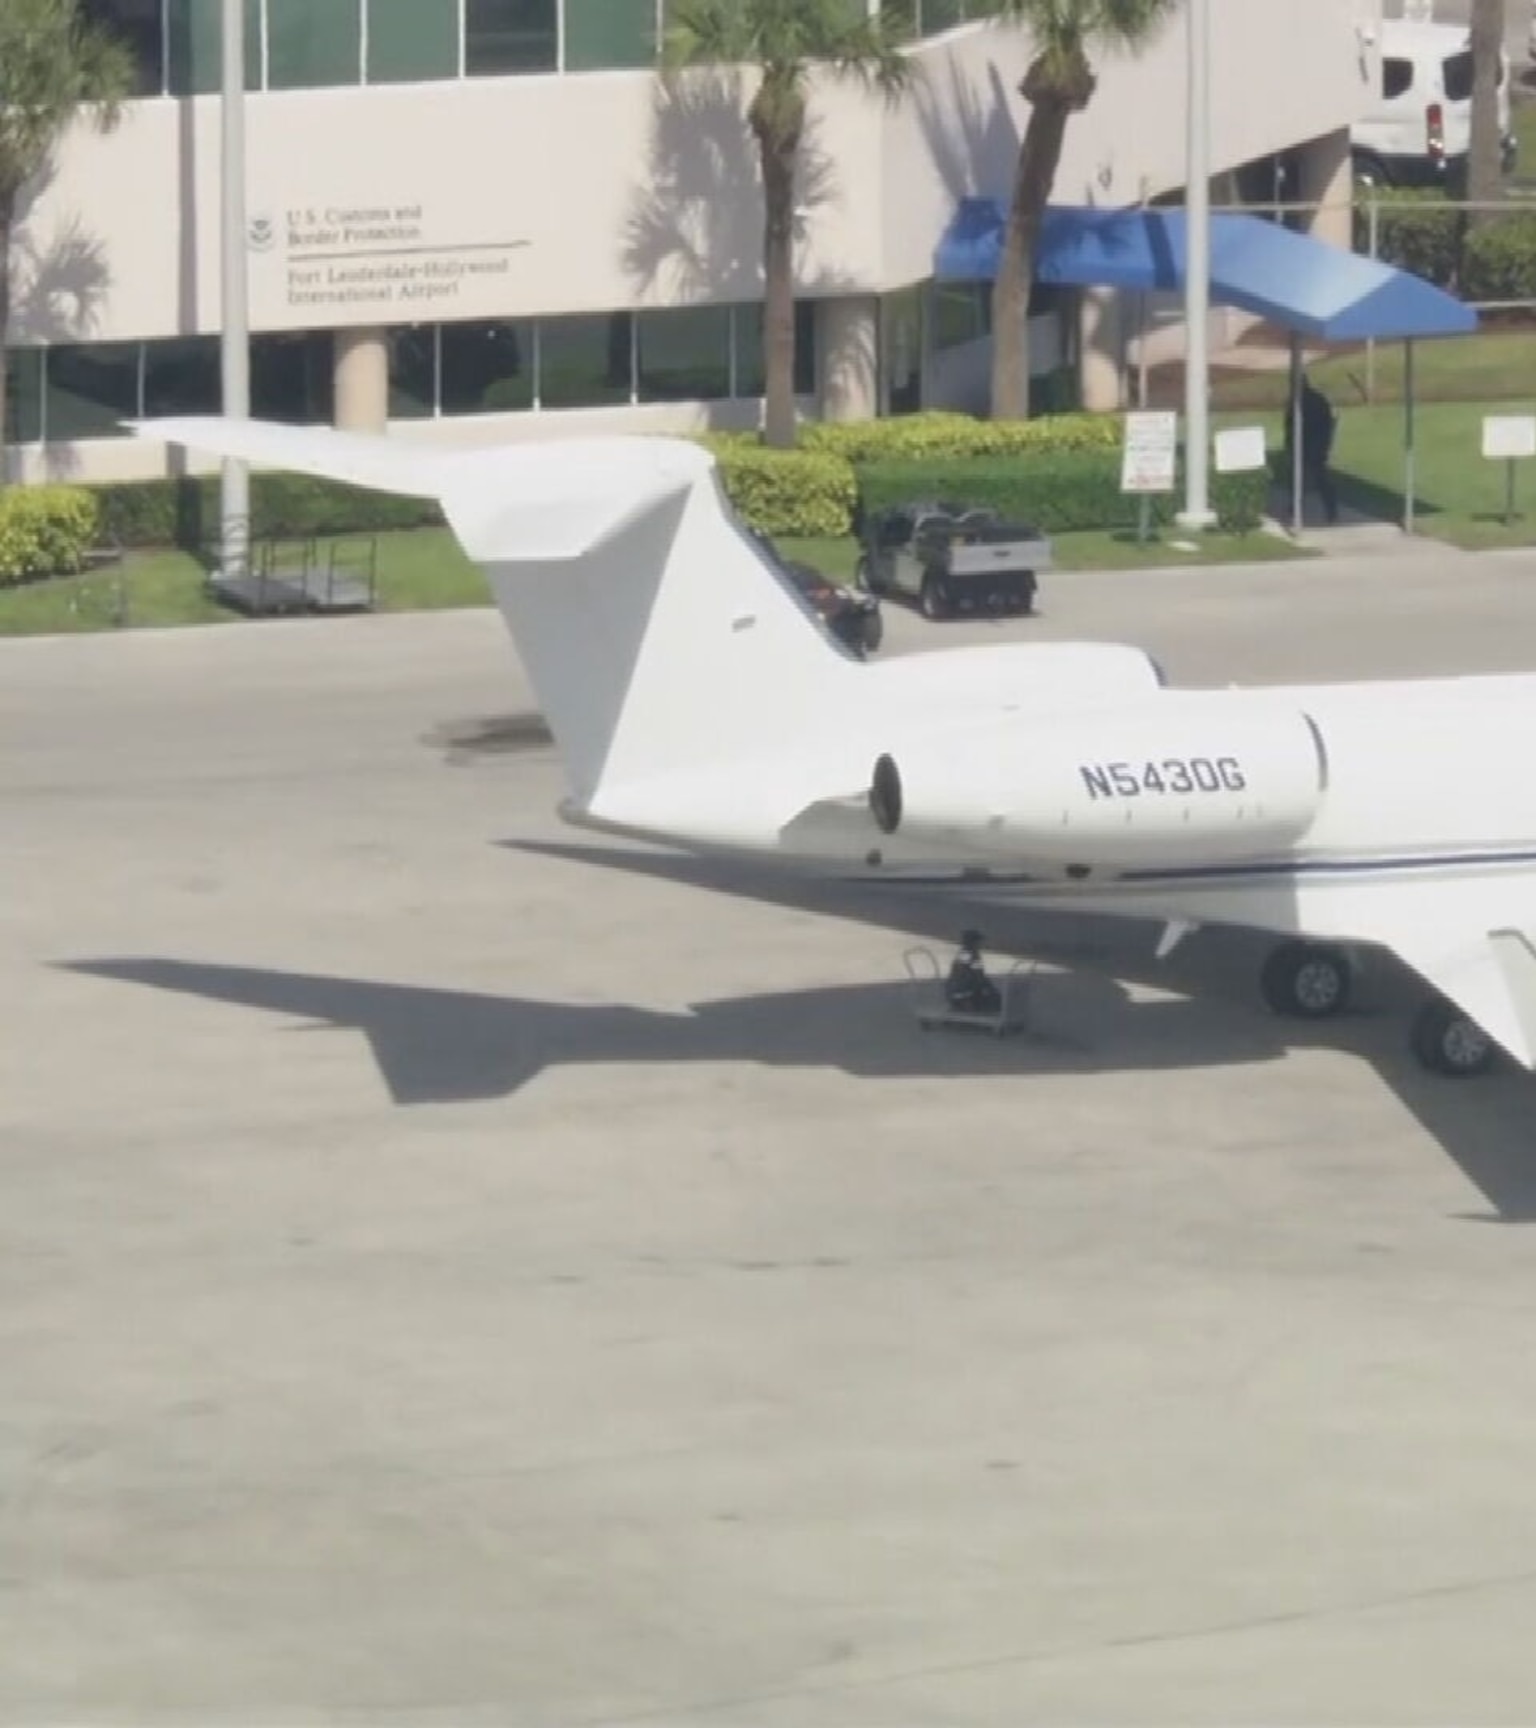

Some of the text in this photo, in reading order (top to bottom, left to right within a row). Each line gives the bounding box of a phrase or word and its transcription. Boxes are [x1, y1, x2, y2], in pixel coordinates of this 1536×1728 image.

[324, 206, 391, 224] Customs
[395, 204, 423, 220] and
[287, 225, 421, 247] Border Protection
[287, 258, 509, 285] Fort Lauderdale-Hollywood
[287, 280, 459, 305] International Airport
[1079, 756, 1247, 801] N5430G
